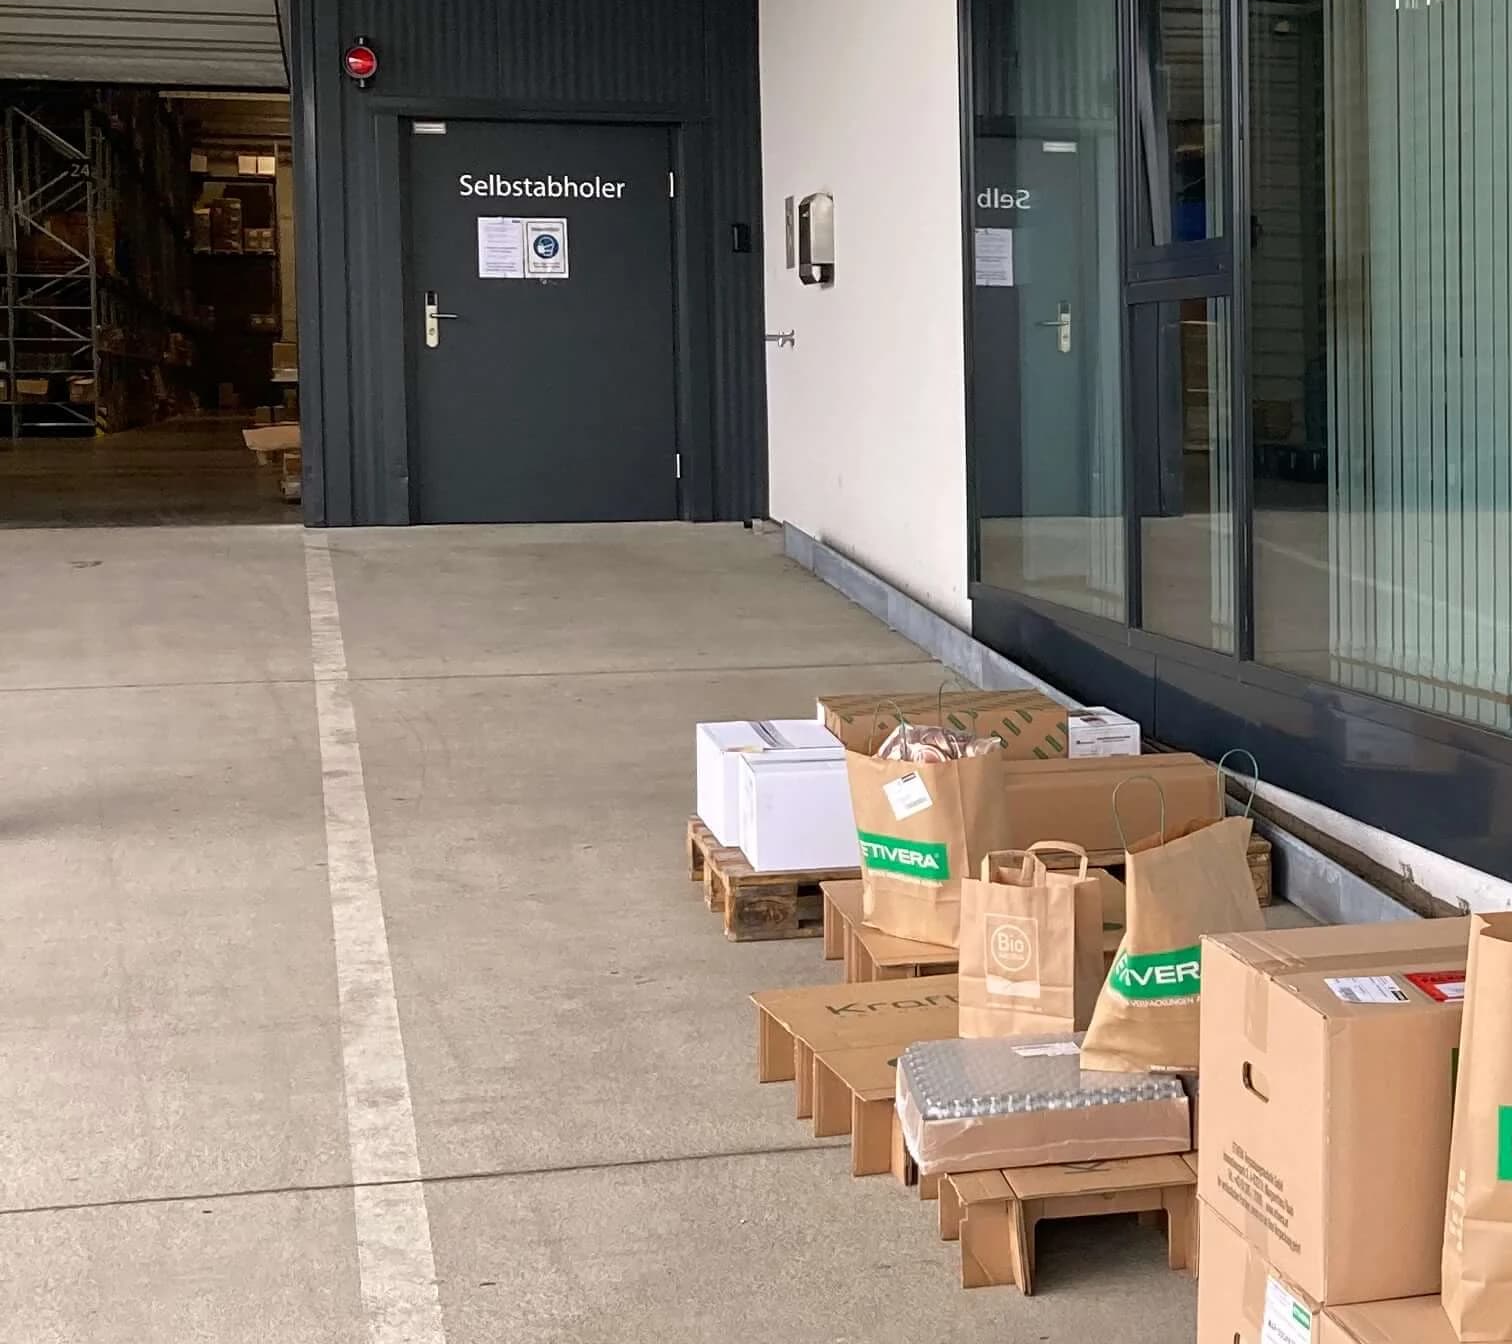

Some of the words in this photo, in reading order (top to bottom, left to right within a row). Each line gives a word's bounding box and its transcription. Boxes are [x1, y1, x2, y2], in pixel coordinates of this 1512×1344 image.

[70, 163, 90, 177] 24
[458, 174, 626, 199] Selbstabholer
[997, 932, 1025, 953] Bio
